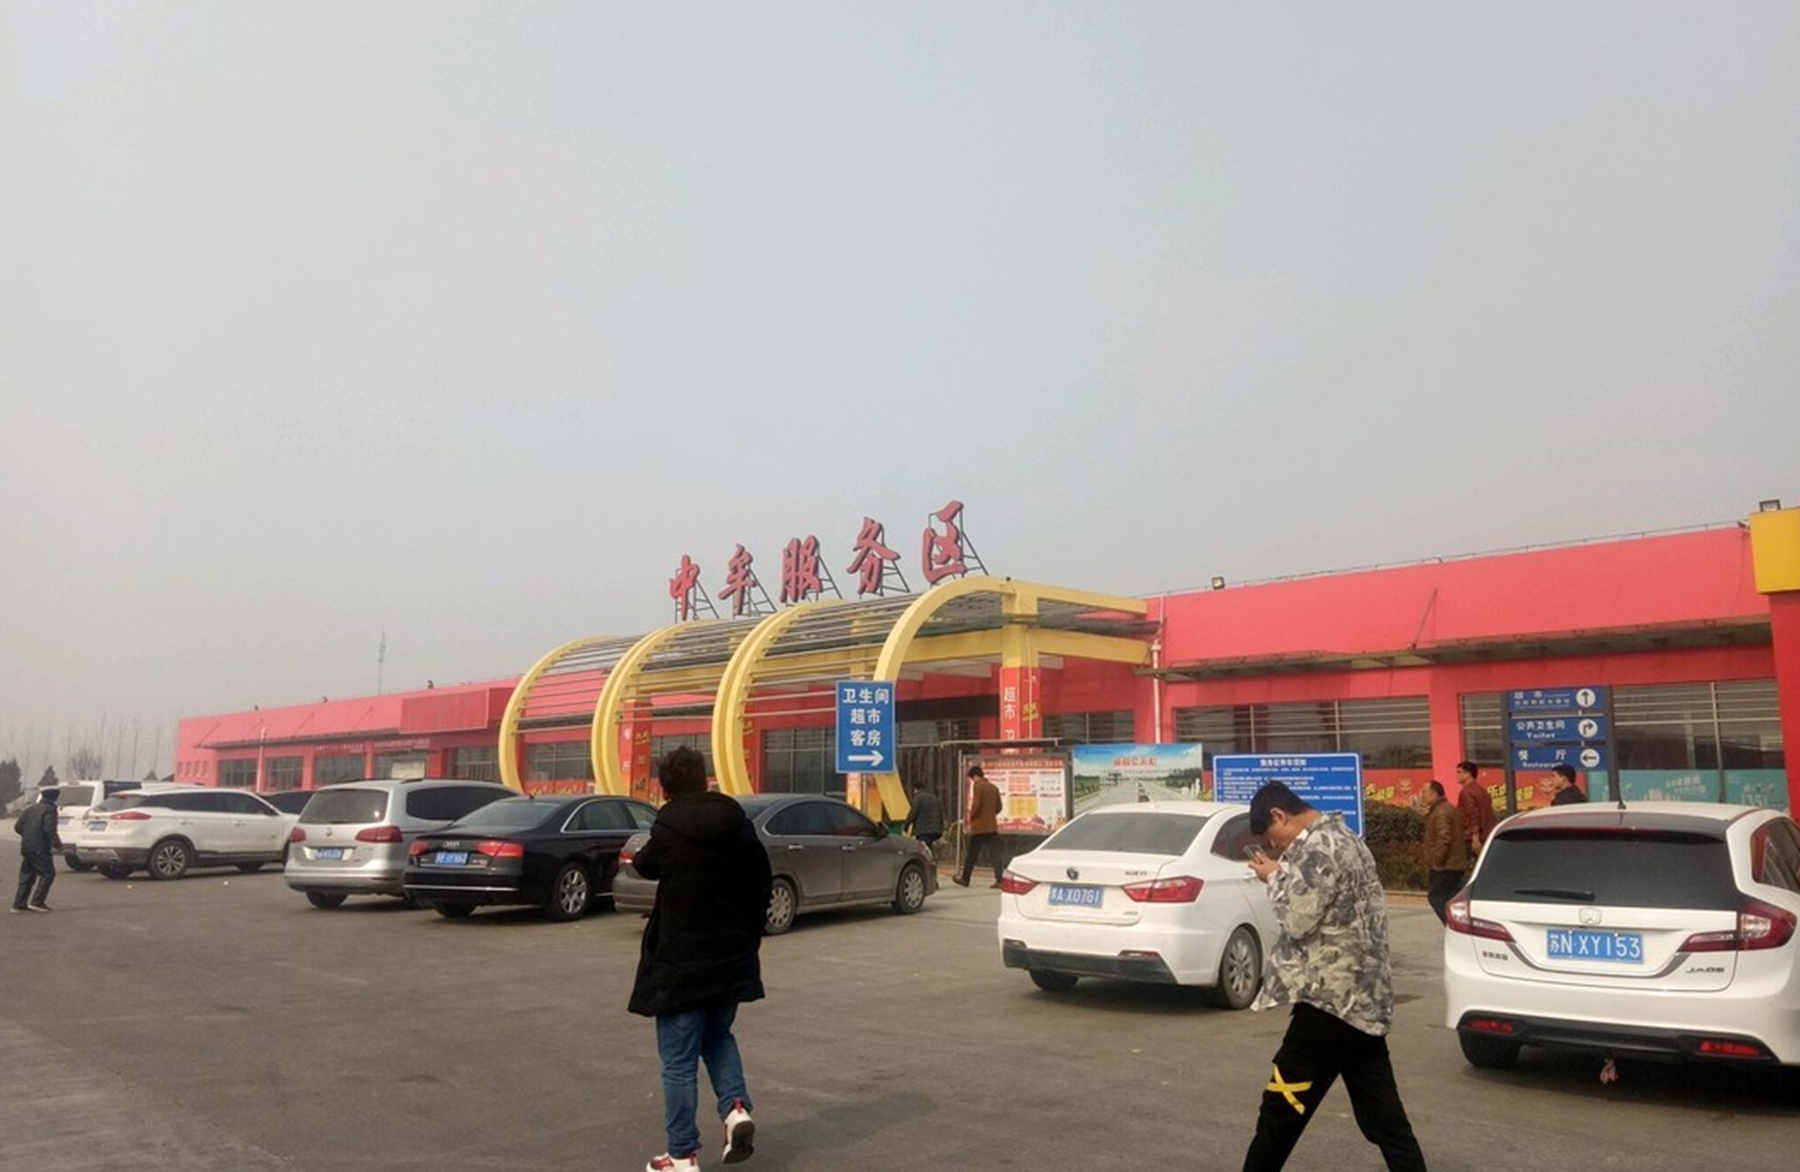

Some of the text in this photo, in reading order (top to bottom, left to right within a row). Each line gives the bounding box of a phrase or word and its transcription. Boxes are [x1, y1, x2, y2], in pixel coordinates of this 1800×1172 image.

[668, 499, 968, 621] 中牟服务区
[842, 687, 890, 704] 卫生间
[1004, 686, 1016, 720] 超市
[850, 708, 881, 725] 超市
[850, 730, 881, 747] 客房
